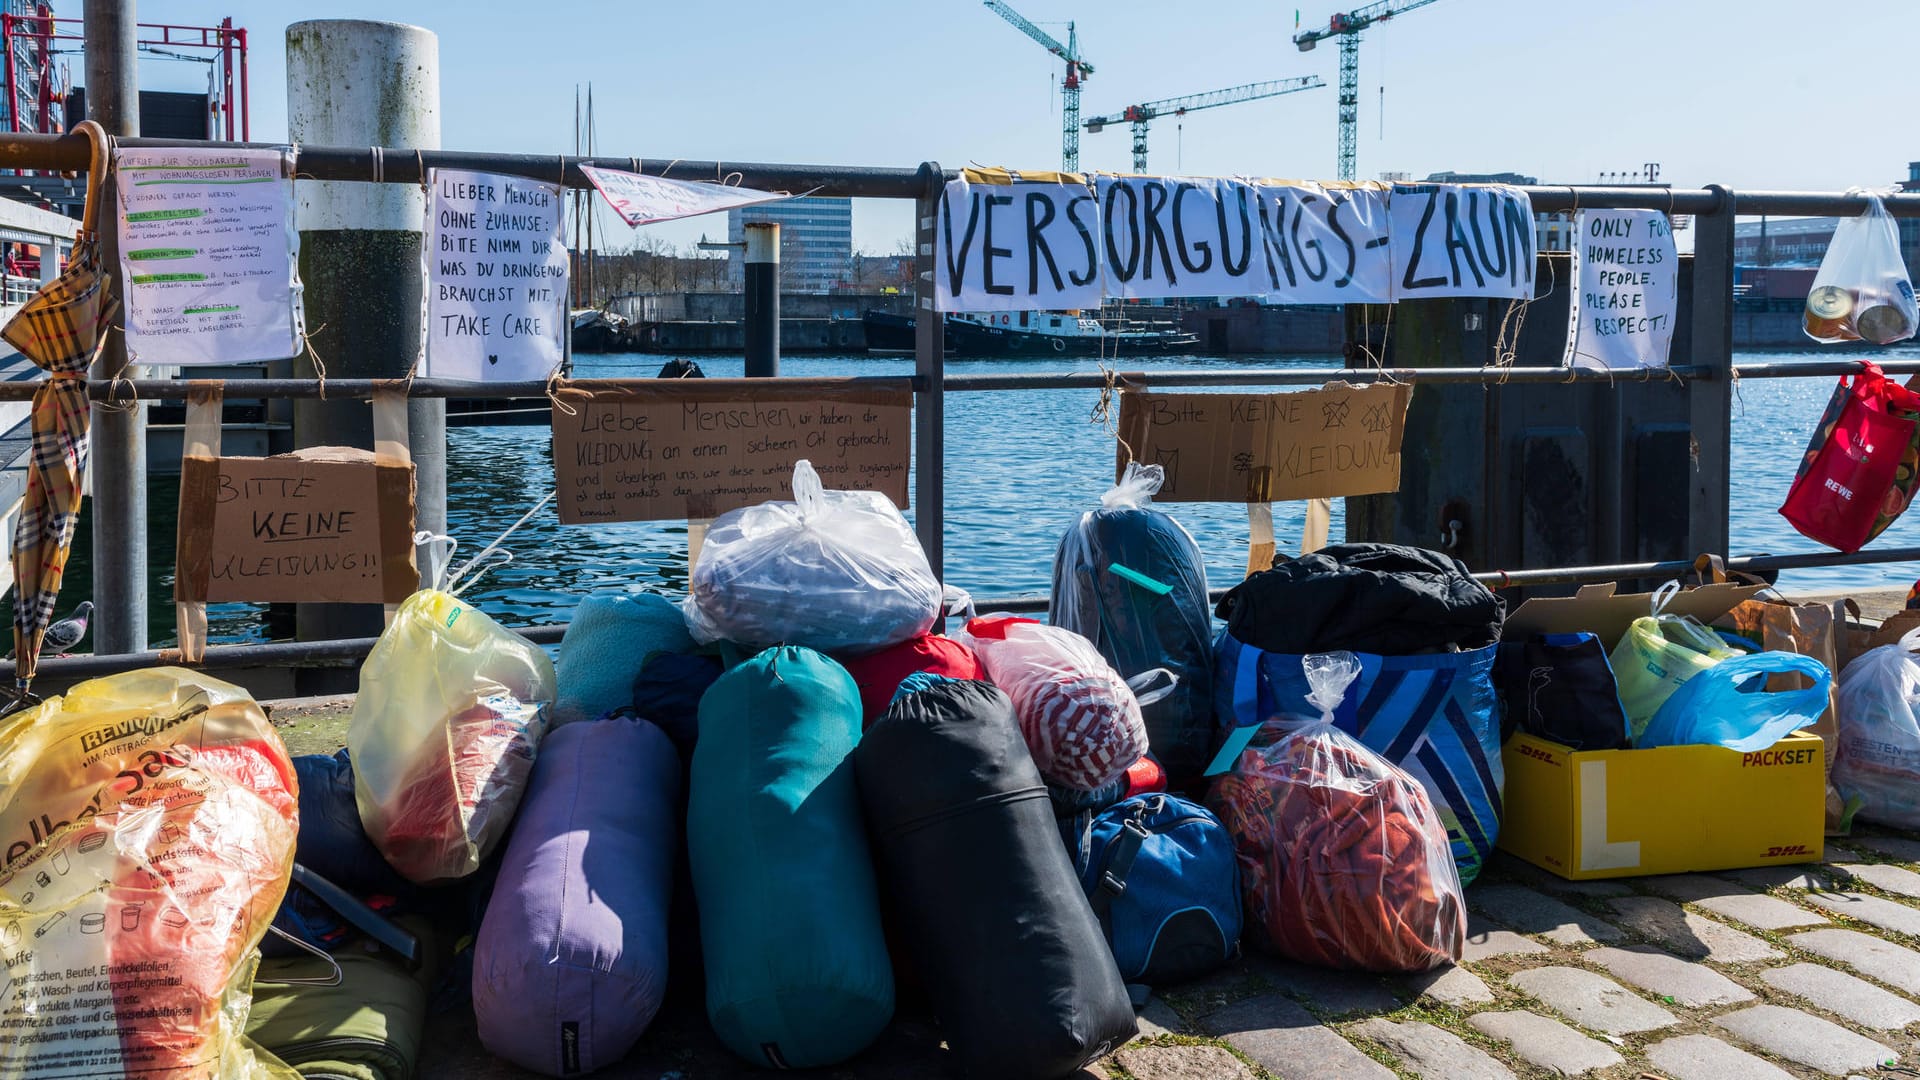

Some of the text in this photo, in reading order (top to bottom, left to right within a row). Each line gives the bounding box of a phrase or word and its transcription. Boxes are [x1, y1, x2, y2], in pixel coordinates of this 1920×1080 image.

[162, 156, 179, 166] ZUR
[132, 171, 146, 179] MIT
[160, 169, 229, 179] WOHNUNGSLOSEN
[443, 180, 549, 207] LIEBER MENSCH
[441, 210, 549, 232] OHNE ZUHAUSE:
[1591, 217, 1671, 239] ONLY FOR
[488, 239, 520, 253] NIMM
[1394, 184, 1534, 290] ZAUN
[1588, 245, 1663, 265] HOMELESS
[440, 260, 564, 279] WAS DU DRINGEND
[1600, 271, 1655, 286] PEOPLE.
[440, 285, 515, 303] BRAUCHST
[1586, 292, 1642, 310] PLEASE
[441, 313, 541, 338] TAKE CARE
[1595, 313, 1667, 337] RESPECT!
[581, 400, 656, 433] Liebe
[682, 400, 796, 431] Menschen,
[819, 406, 853, 425] haben
[863, 407, 878, 424] die
[1153, 399, 1304, 426] Bitte KEINE
[576, 439, 653, 466] KLEIDUNG
[663, 445, 680, 460] an
[692, 443, 728, 457] einen
[747, 433, 797, 454] sicheren
[806, 430, 826, 448] Ort
[1277, 441, 1399, 478] KLEIDUNG
[576, 472, 600, 488] und
[703, 469, 720, 478] wie
[728, 463, 754, 478] diese
[215, 474, 317, 503] BITTE
[595, 489, 616, 500] oder
[625, 486, 660, 498] anders
[672, 486, 693, 497] den
[1825, 477, 1854, 501] REWE
[252, 510, 357, 539] KEINE
[209, 554, 378, 581] KLEIDUNG!!
[87, 753, 100, 765] IM
[1518, 743, 1557, 766] DHL
[1742, 749, 1816, 768] PACKSET
[1580, 760, 1641, 872] L
[1764, 845, 1812, 857] DHL
[66, 966, 97, 978] Beutel,
[42, 985, 76, 997] Wasch-
[78, 981, 95, 992] und
[97, 975, 183, 994] Körperpflegemittel
[74, 996, 121, 1010] Margarine
[82, 1012, 100, 1022] und
